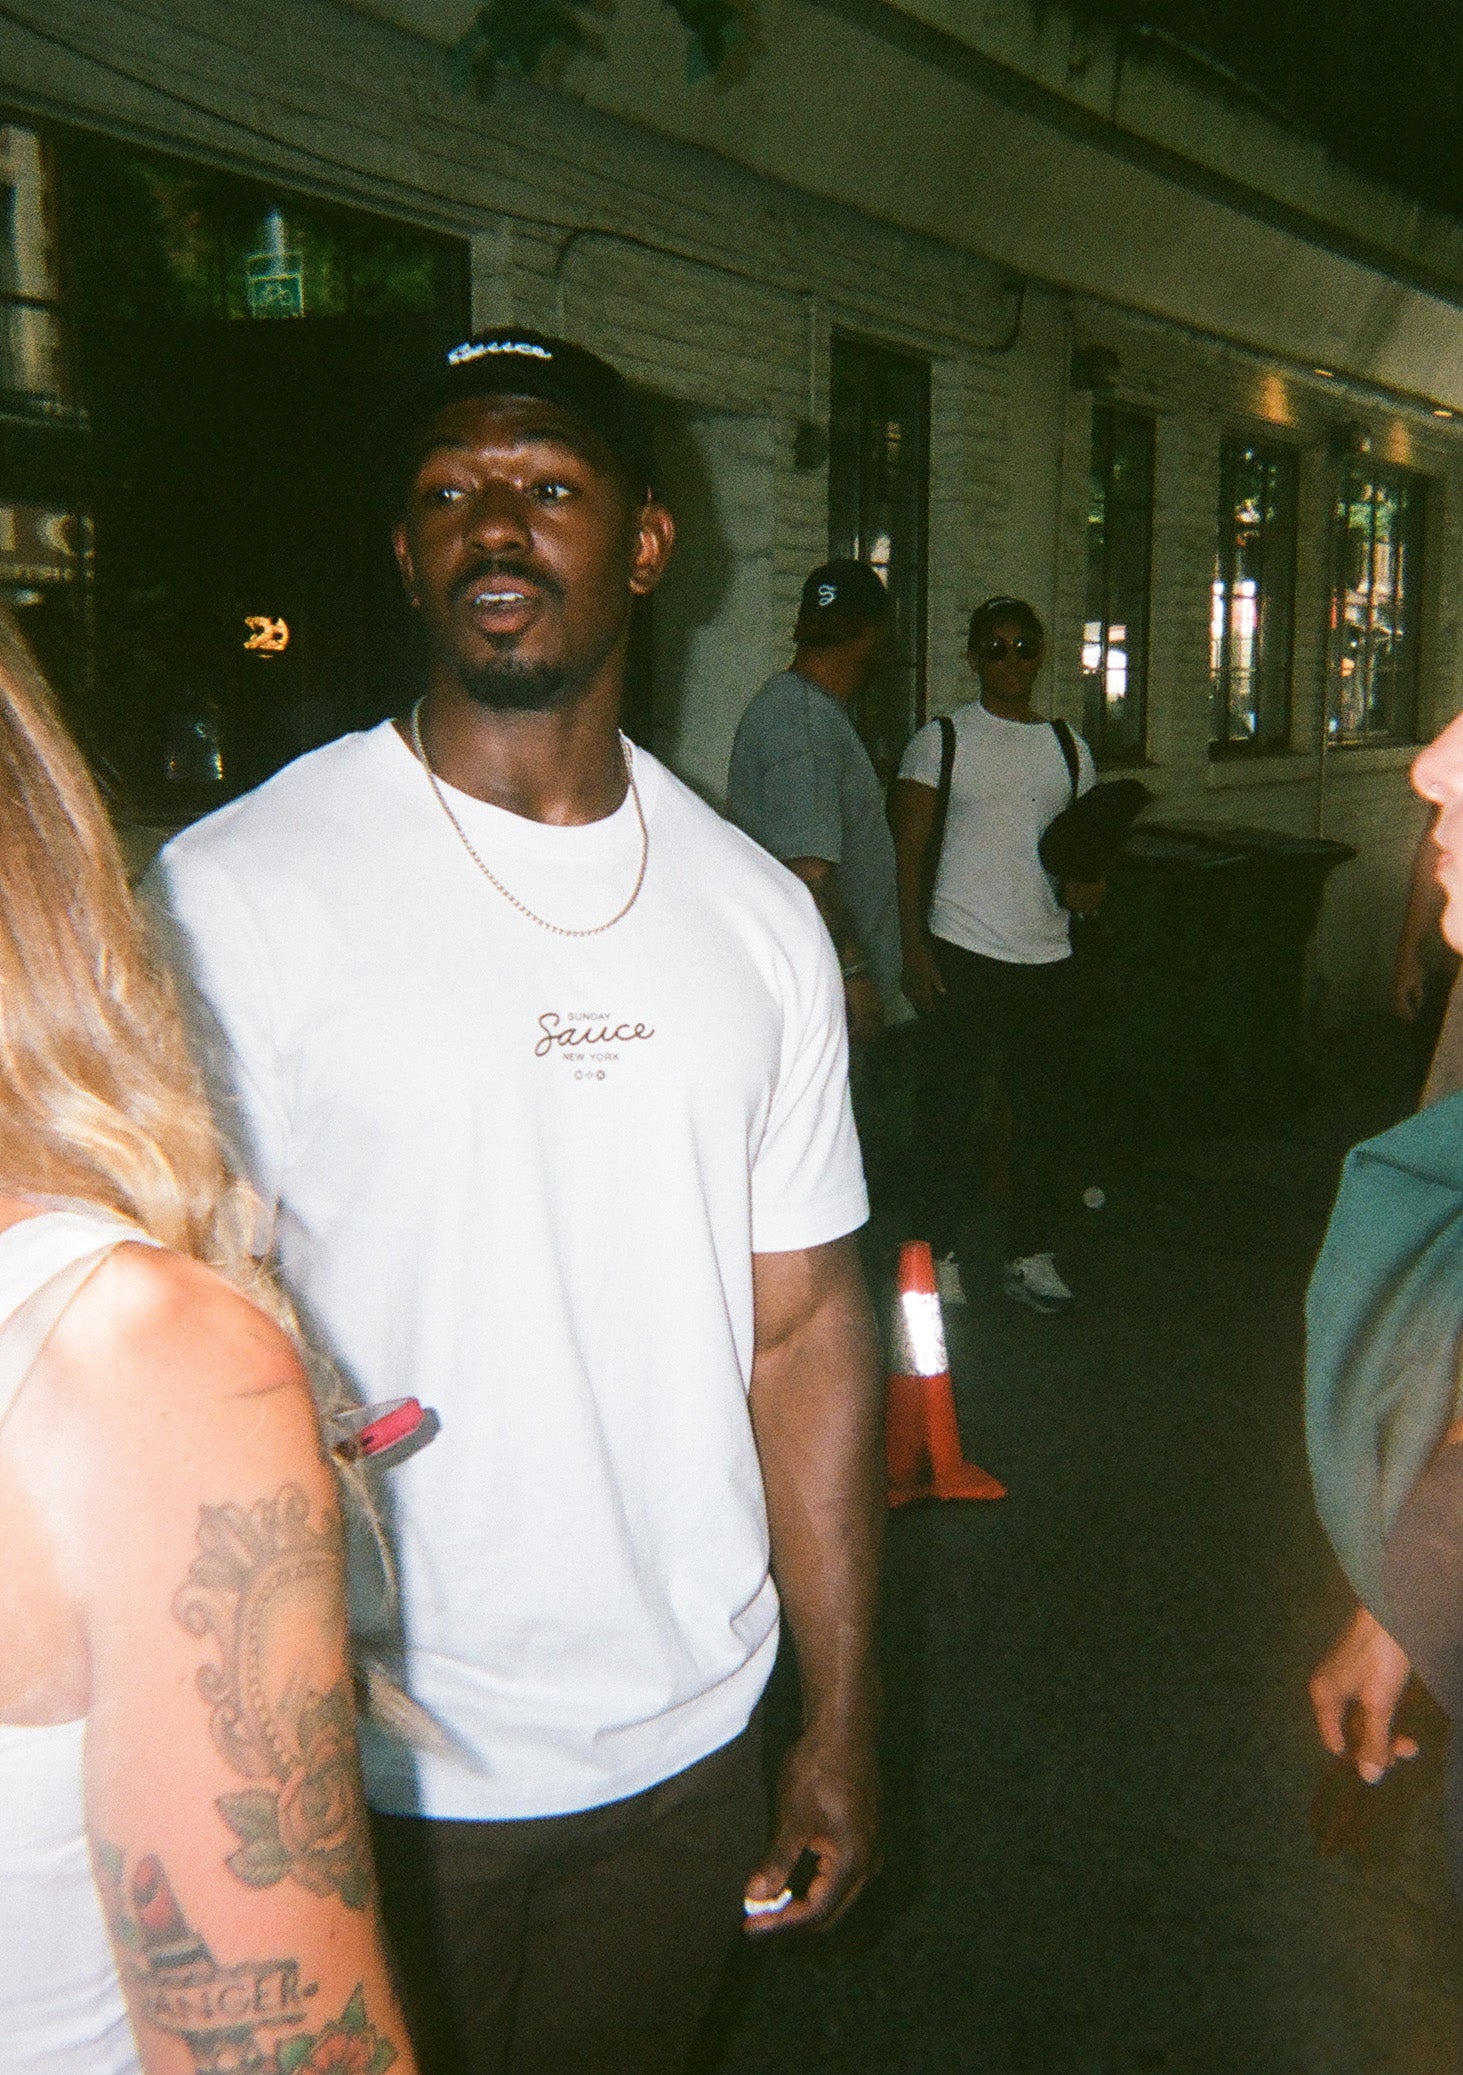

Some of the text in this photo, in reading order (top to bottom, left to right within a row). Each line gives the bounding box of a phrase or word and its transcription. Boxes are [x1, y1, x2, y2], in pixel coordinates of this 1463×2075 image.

[567, 1012, 611, 1021] SUNDAY
[535, 1012, 655, 1057] Sauce
[562, 1053, 620, 1061] NEW YORK
